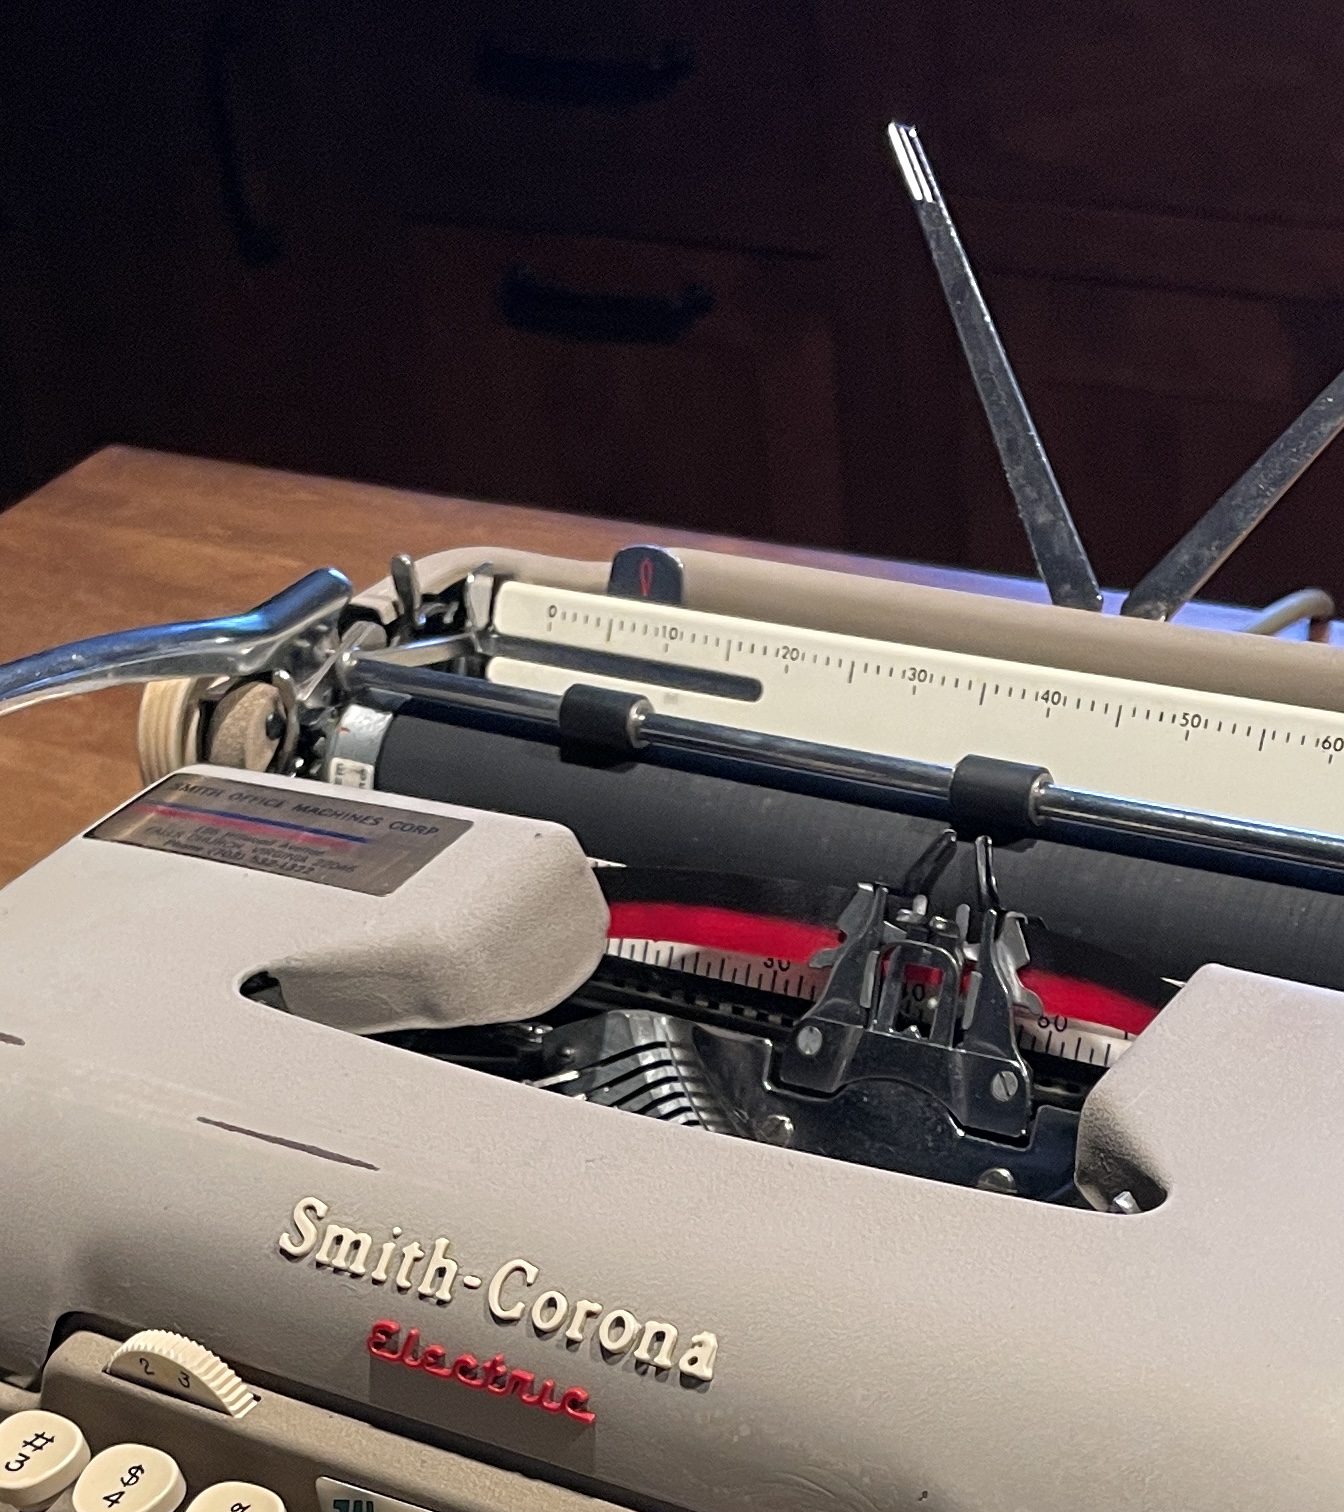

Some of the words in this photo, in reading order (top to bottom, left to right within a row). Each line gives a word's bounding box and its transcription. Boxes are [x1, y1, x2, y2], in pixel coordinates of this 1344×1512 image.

[548, 605, 557, 618] 0
[662, 627, 678, 641] 10
[781, 646, 800, 661] 20
[909, 668, 928, 683] 30
[1041, 691, 1062, 706] 40
[1180, 713, 1202, 729] 50
[1322, 736, 1344, 752] 60
[292, 803, 384, 827] MACHINES
[389, 820, 439, 836] CORP
[278, 1196, 719, 1382] Smith-Corona
[139, 1358, 154, 1376] 2
[367, 1318, 597, 1425] Electric
[178, 1372, 190, 1388] 3
[23, 1432, 54, 1452] #
[5, 1453, 30, 1472] 3
[121, 1465, 144, 1487] $
[103, 1491, 125, 1508] 4
